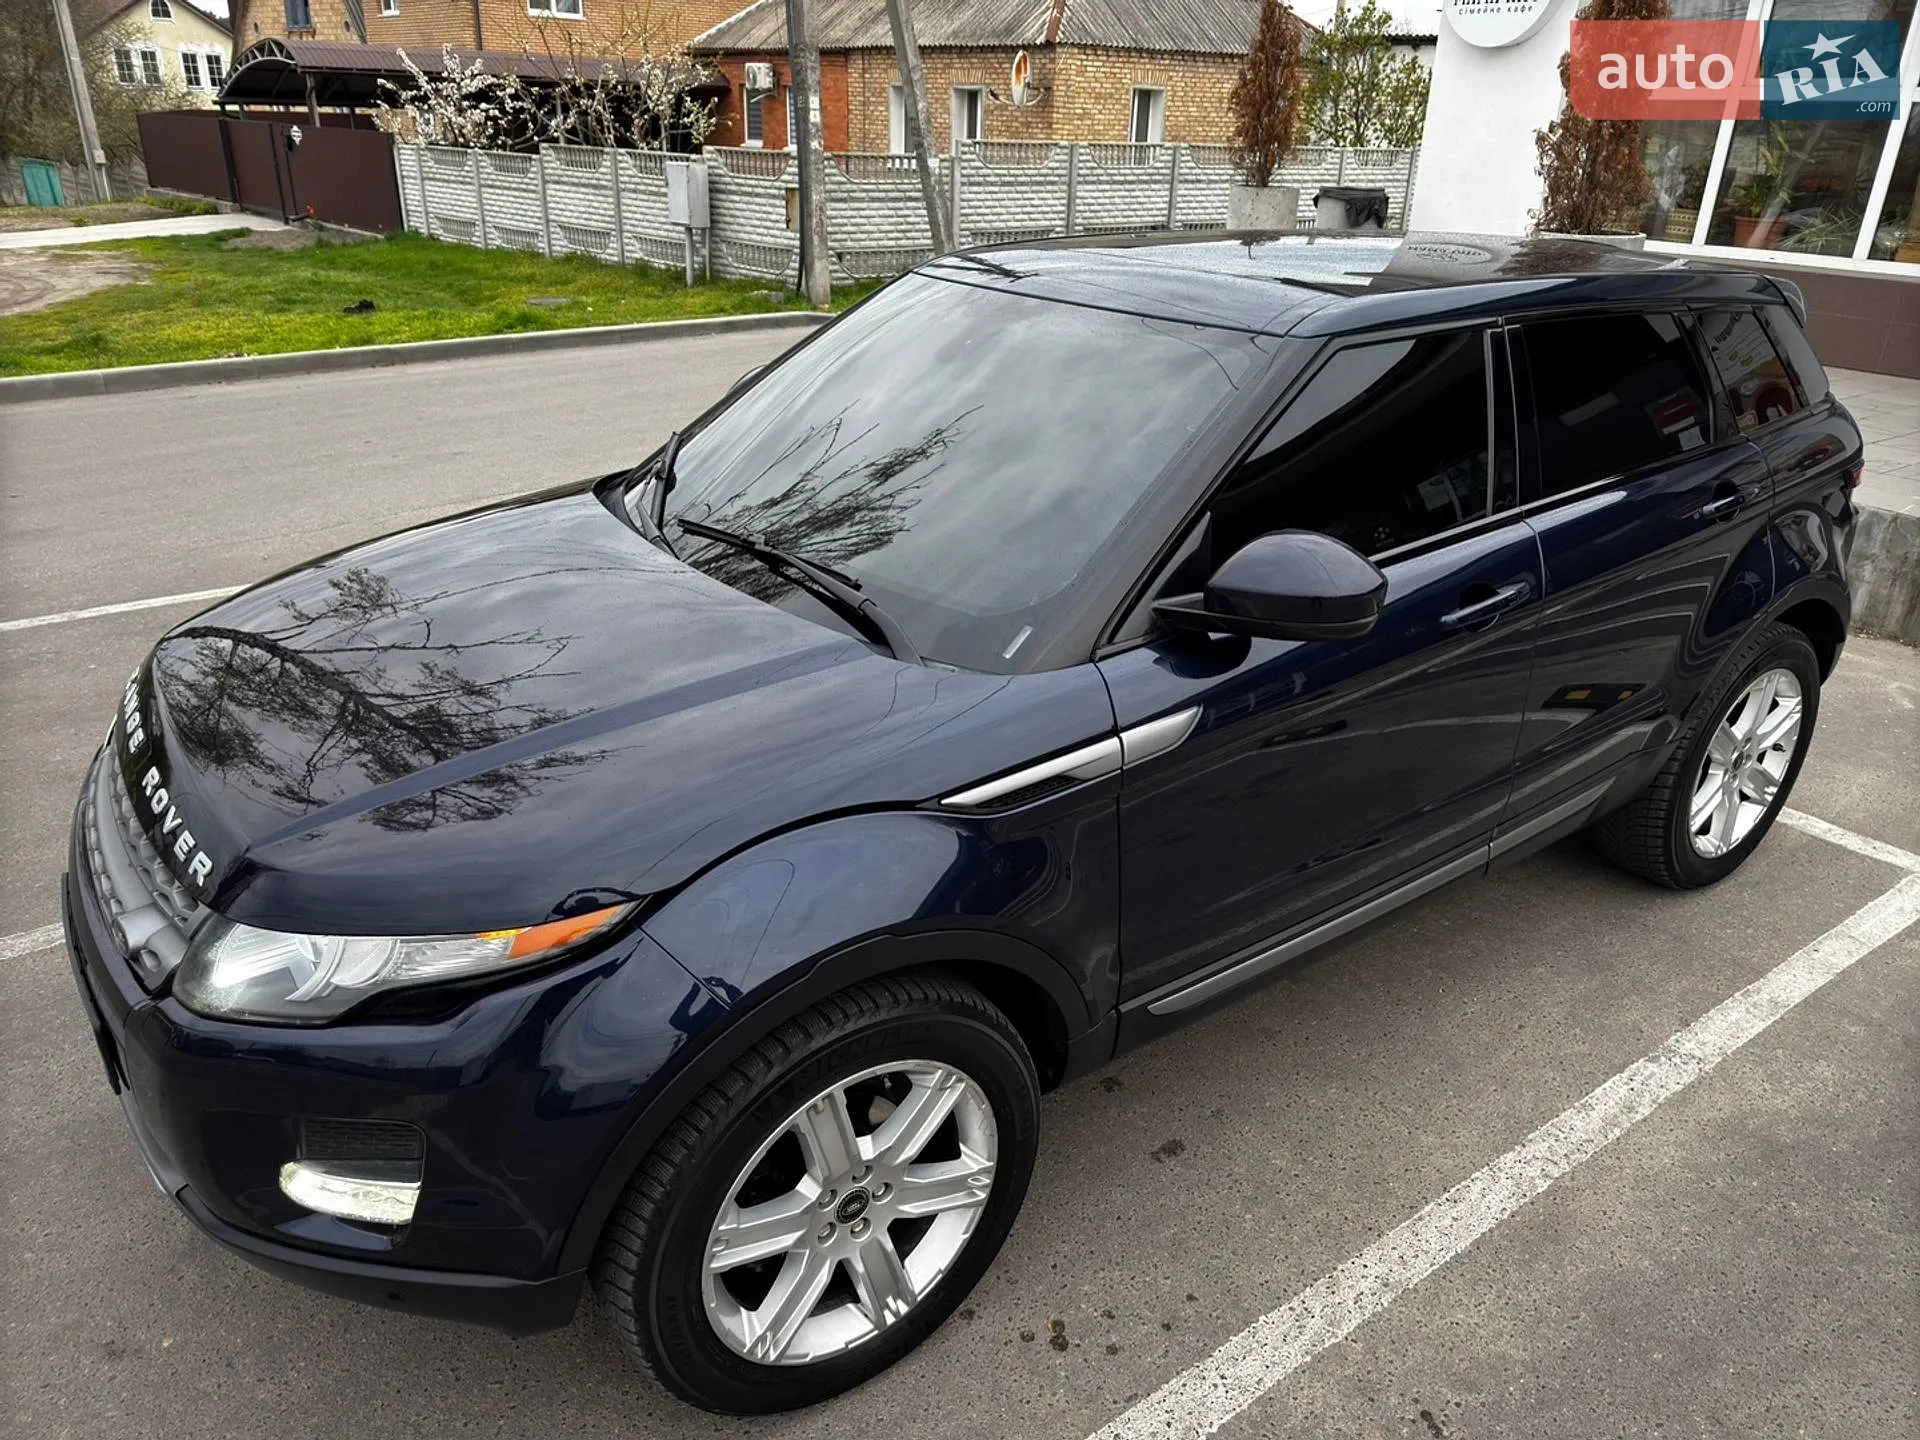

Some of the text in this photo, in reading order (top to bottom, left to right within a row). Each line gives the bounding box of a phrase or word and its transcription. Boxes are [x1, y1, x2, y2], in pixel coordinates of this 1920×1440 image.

[1458, 4, 1533, 15] сімейне кафе
[141, 766, 213, 887] ROVER
